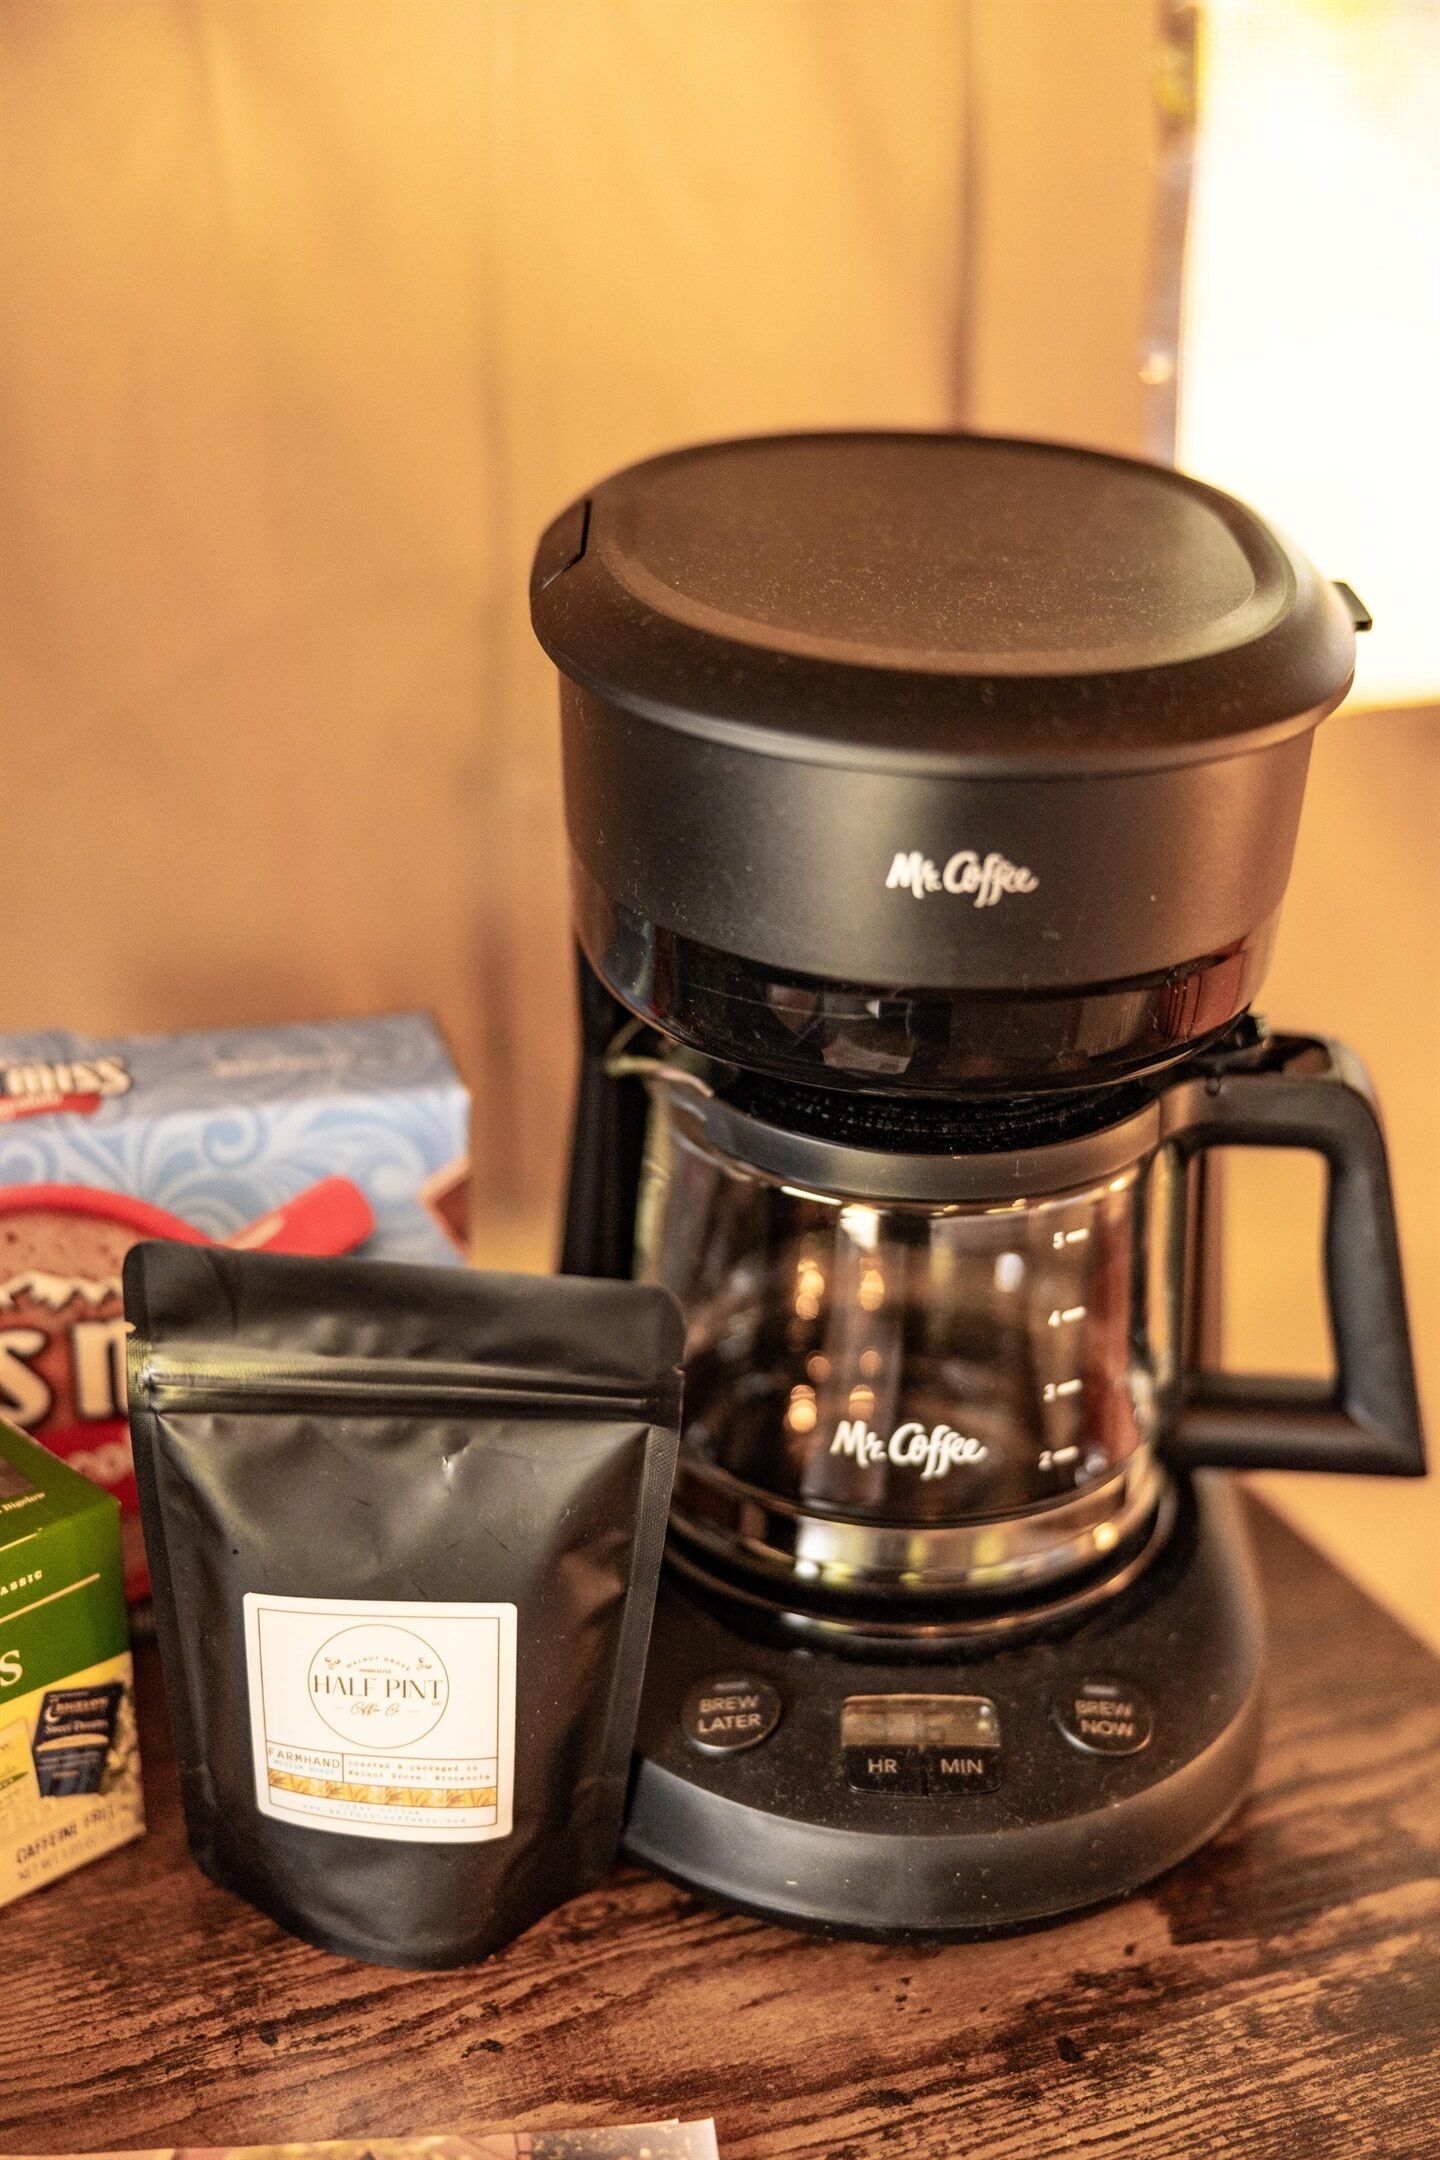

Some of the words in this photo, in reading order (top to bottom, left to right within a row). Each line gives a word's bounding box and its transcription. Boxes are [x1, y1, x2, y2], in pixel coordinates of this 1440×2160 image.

[885, 851, 942, 899] Mr.
[943, 850, 1039, 908] Coffee
[830, 1420, 886, 1468] Mr.
[888, 1422, 988, 1481] Coffee
[345, 1655, 379, 1669] WALNUT
[383, 1656, 411, 1672] GROVE
[314, 1674, 377, 1697] HALF
[386, 1678, 443, 1699] PINT
[350, 1700, 381, 1716] Coffee
[699, 1695, 760, 1713] BREW
[1075, 1699, 1133, 1717] BREW
[698, 1712, 762, 1733] LATER
[1080, 1719, 1134, 1737] NOW
[268, 1746, 341, 1769] FARMHAND
[868, 1757, 898, 1774] HR
[940, 1757, 985, 1775] MIN
